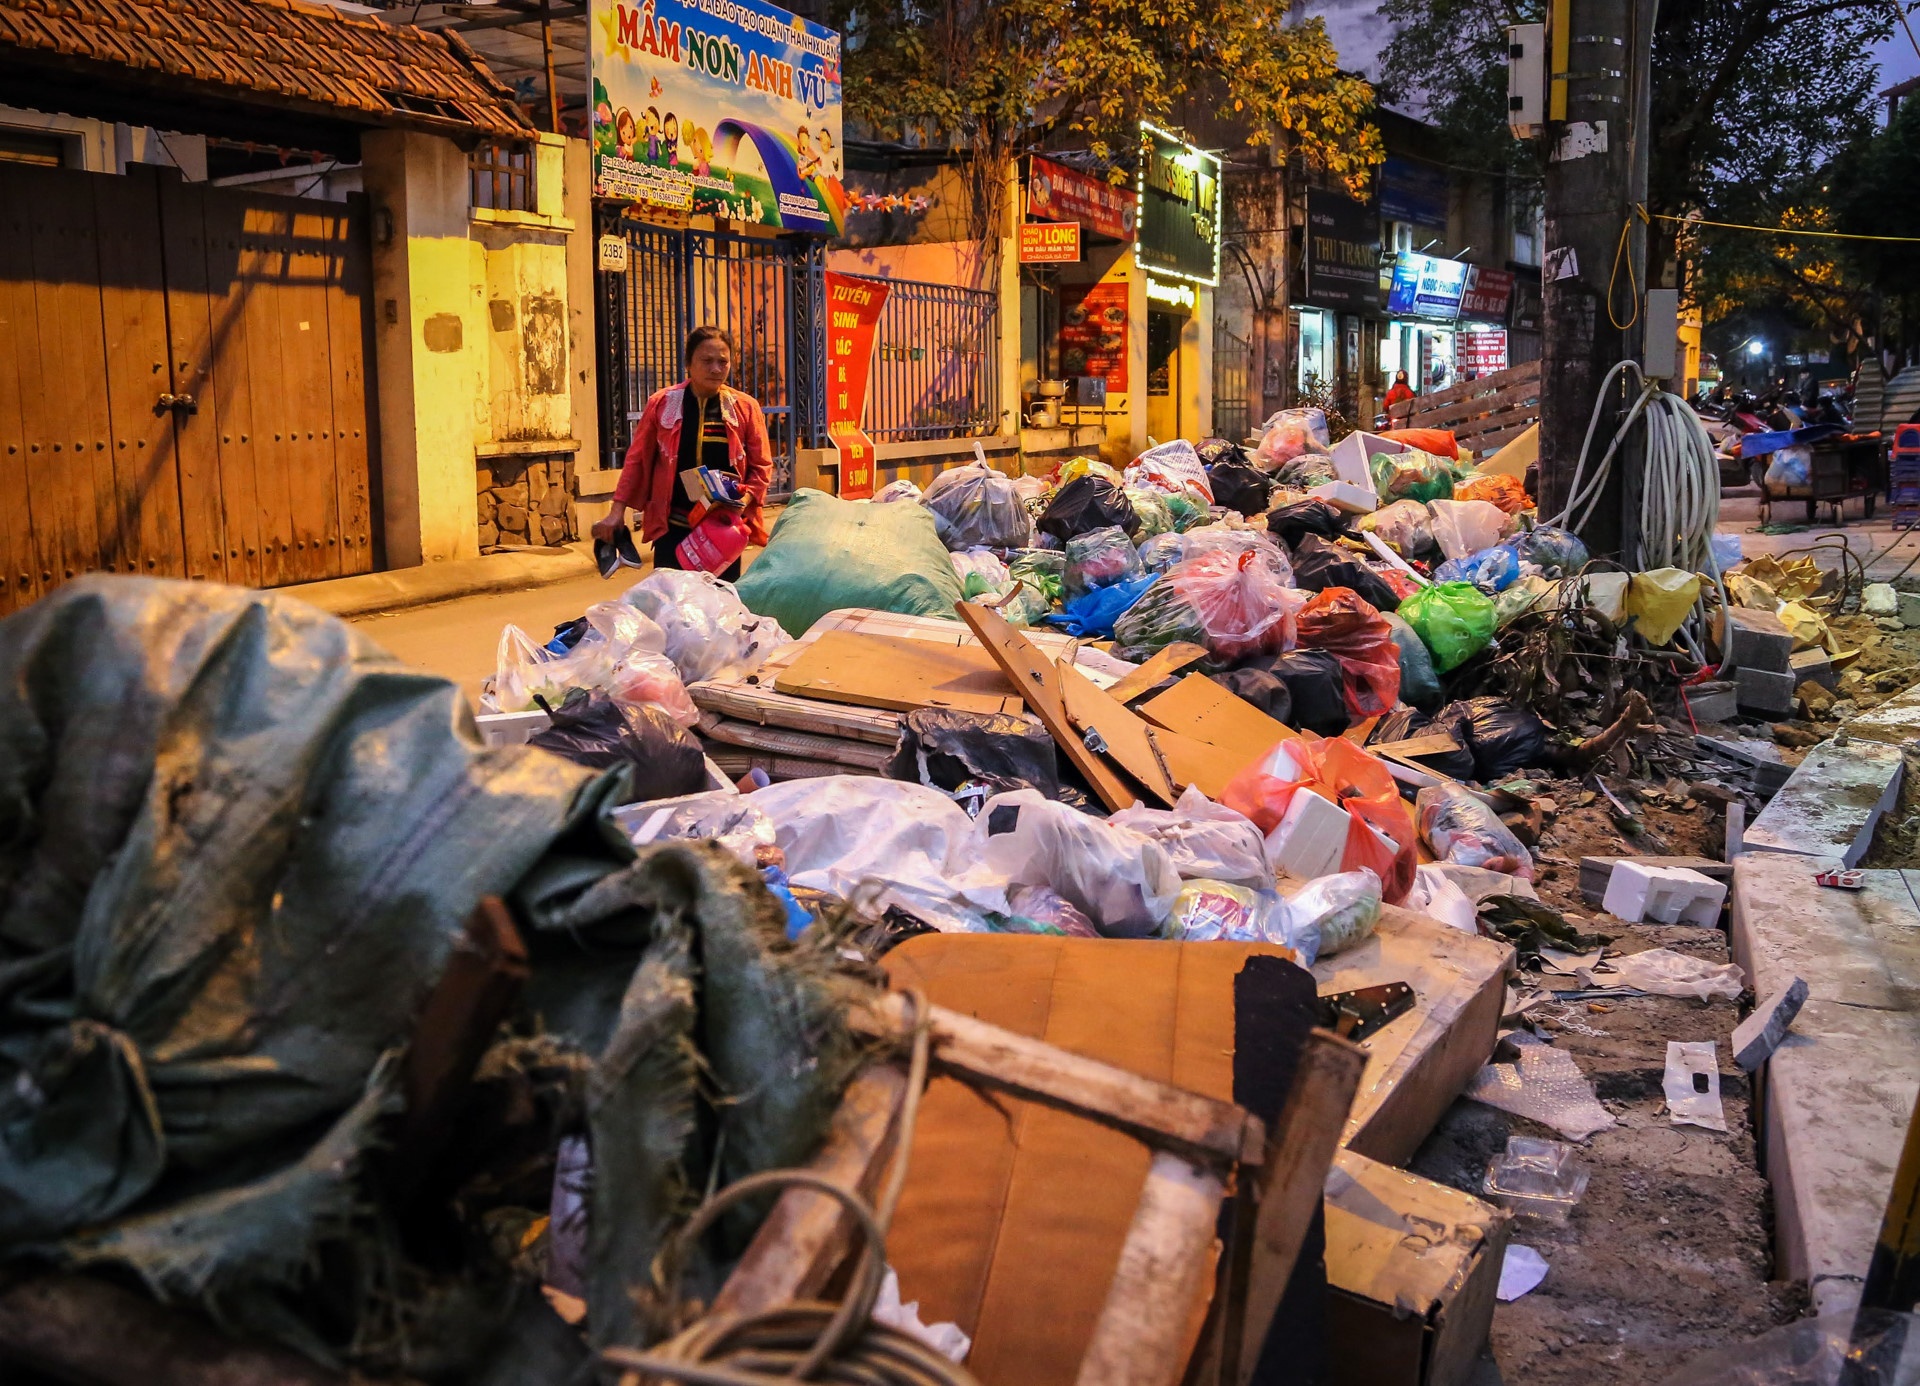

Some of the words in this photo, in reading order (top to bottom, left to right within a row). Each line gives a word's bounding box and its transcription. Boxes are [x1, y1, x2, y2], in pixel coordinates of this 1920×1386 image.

[737, 7, 756, 30] TẠO
[759, 17, 783, 41] QUẬN
[785, 27, 813, 51] THANH
[813, 38, 838, 59] XUÂN
[617, 0, 681, 62] MẦM
[686, 30, 740, 82] NON
[746, 51, 793, 99] ANH
[798, 66, 826, 109] VŨ
[639, 188, 649, 198] 193
[1023, 227, 1038, 236] CHÁO
[1045, 225, 1075, 244] LÒNG
[1023, 236, 1038, 245] BÚN
[604, 243, 623, 259] 23B2
[1314, 236, 1337, 261] THU
[1339, 241, 1376, 267] TRANG
[832, 285, 871, 305] TUYỂN
[833, 311, 860, 329] SINH
[1467, 355, 1475, 364] XE
[1476, 354, 1485, 364] GA
[1488, 354, 1496, 364] XE
[1497, 351, 1505, 364] SỐ
[849, 470, 854, 487] 5
